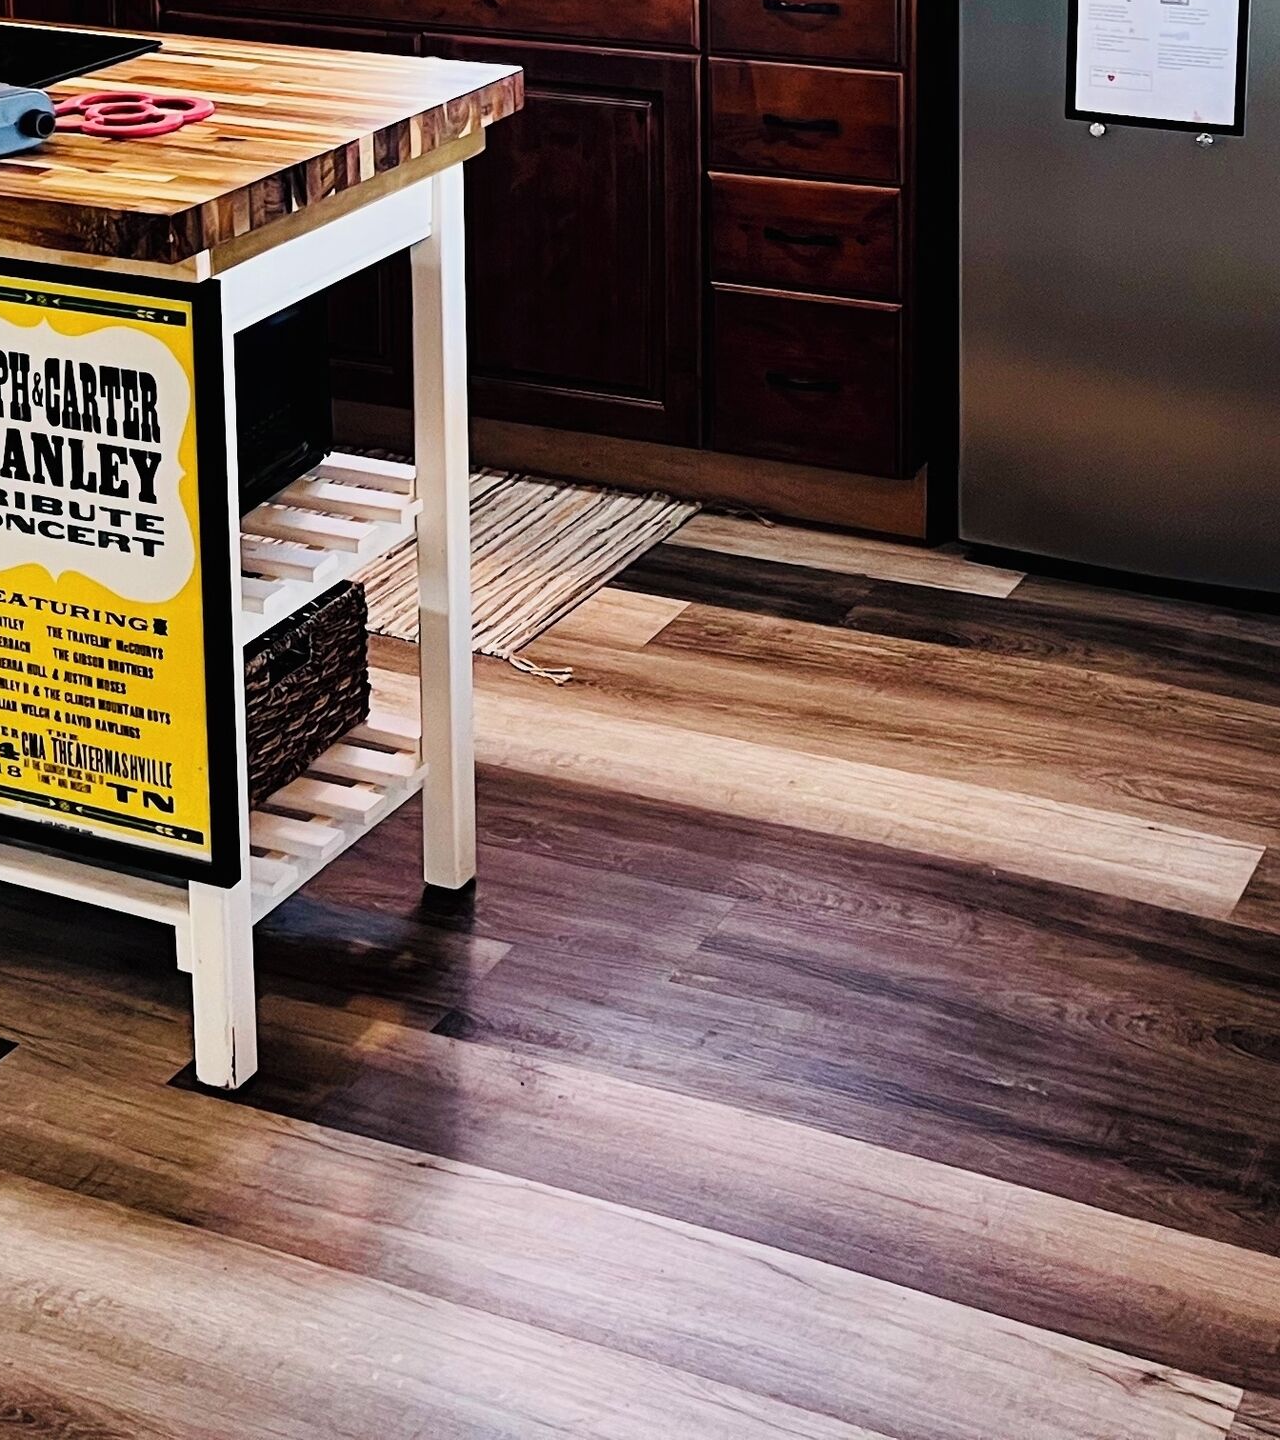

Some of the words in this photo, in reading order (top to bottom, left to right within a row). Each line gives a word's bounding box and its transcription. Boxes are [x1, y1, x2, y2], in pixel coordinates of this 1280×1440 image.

[44, 357, 161, 443] CARTER
[46, 625, 63, 640] THE
[52, 668, 60, 681] &
[64, 670, 93, 688] JUSTIN
[53, 647, 69, 662] THE
[73, 651, 104, 669] GIBSON
[108, 658, 154, 679] BROTHERS
[21, 702, 50, 720] WELCH
[54, 709, 62, 723] &
[65, 712, 92, 729] DAVID
[33, 684, 41, 697] &
[44, 686, 61, 702] THE
[98, 698, 145, 720] MOUNTAIN
[147, 708, 171, 725] BOYS
[21, 731, 46, 761] CMA
[51, 737, 103, 773] THEATER
[104, 750, 173, 789] NASHVILLE
[106, 781, 175, 814] TN
